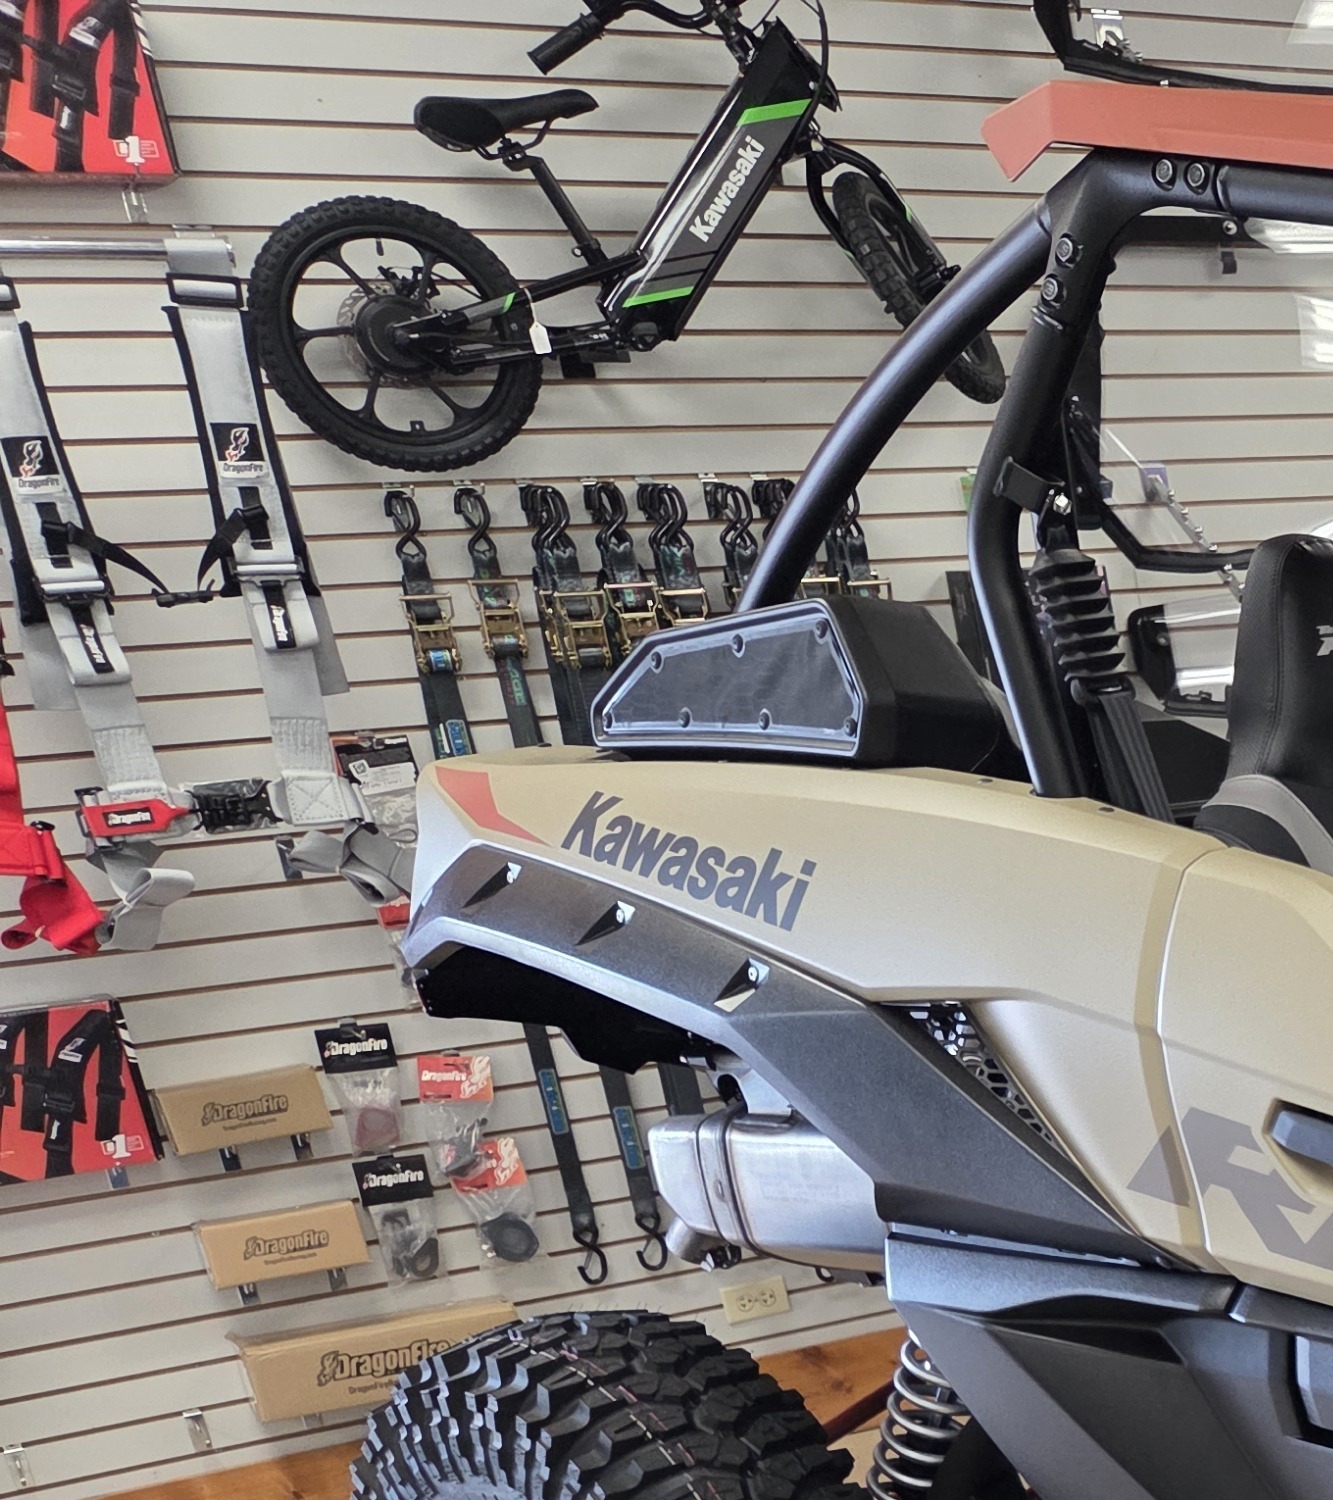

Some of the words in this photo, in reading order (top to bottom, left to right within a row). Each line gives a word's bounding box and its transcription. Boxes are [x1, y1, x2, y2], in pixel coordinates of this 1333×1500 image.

[689, 135, 765, 242] Kawasaki
[560, 790, 818, 932] Kawasaki
[330, 1037, 388, 1056] DragonFire
[212, 1094, 289, 1121] DragonFire
[368, 1169, 425, 1188] DragonFire
[253, 1229, 330, 1257] DragonFire
[333, 1338, 450, 1382] DragonFire
